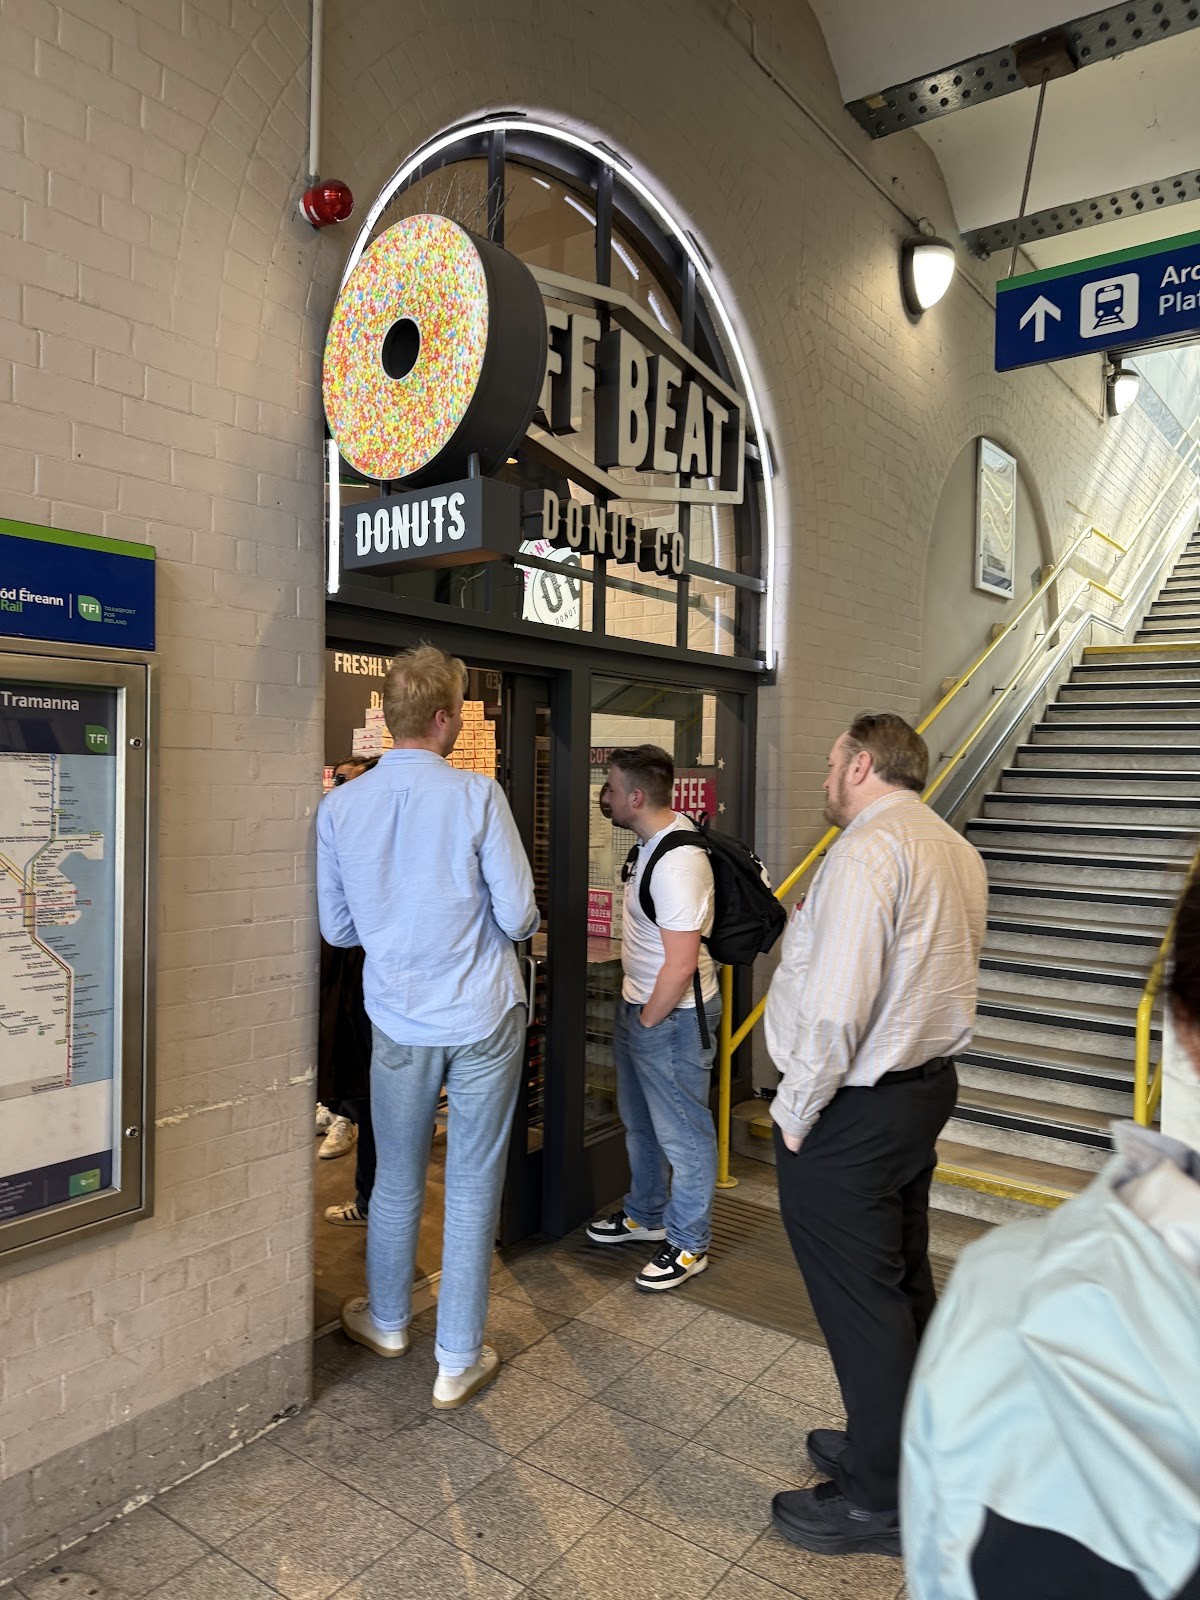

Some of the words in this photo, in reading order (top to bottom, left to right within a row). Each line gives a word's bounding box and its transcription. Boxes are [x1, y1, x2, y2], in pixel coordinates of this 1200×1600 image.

[1159, 265, 1200, 289] Arc
[618, 328, 729, 477] BEAT
[355, 492, 466, 556] DONUTS
[542, 488, 643, 563] DONUT
[654, 526, 686, 575] CO
[1, 600, 23, 612] Rail
[19, 588, 64, 606] Éireann
[81, 603, 100, 614] TFI
[103, 605, 136, 615] TRANSPORT
[103, 617, 128, 626] IRELAND
[0, 691, 80, 711] Tramanna
[88, 733, 108, 745] TFI
